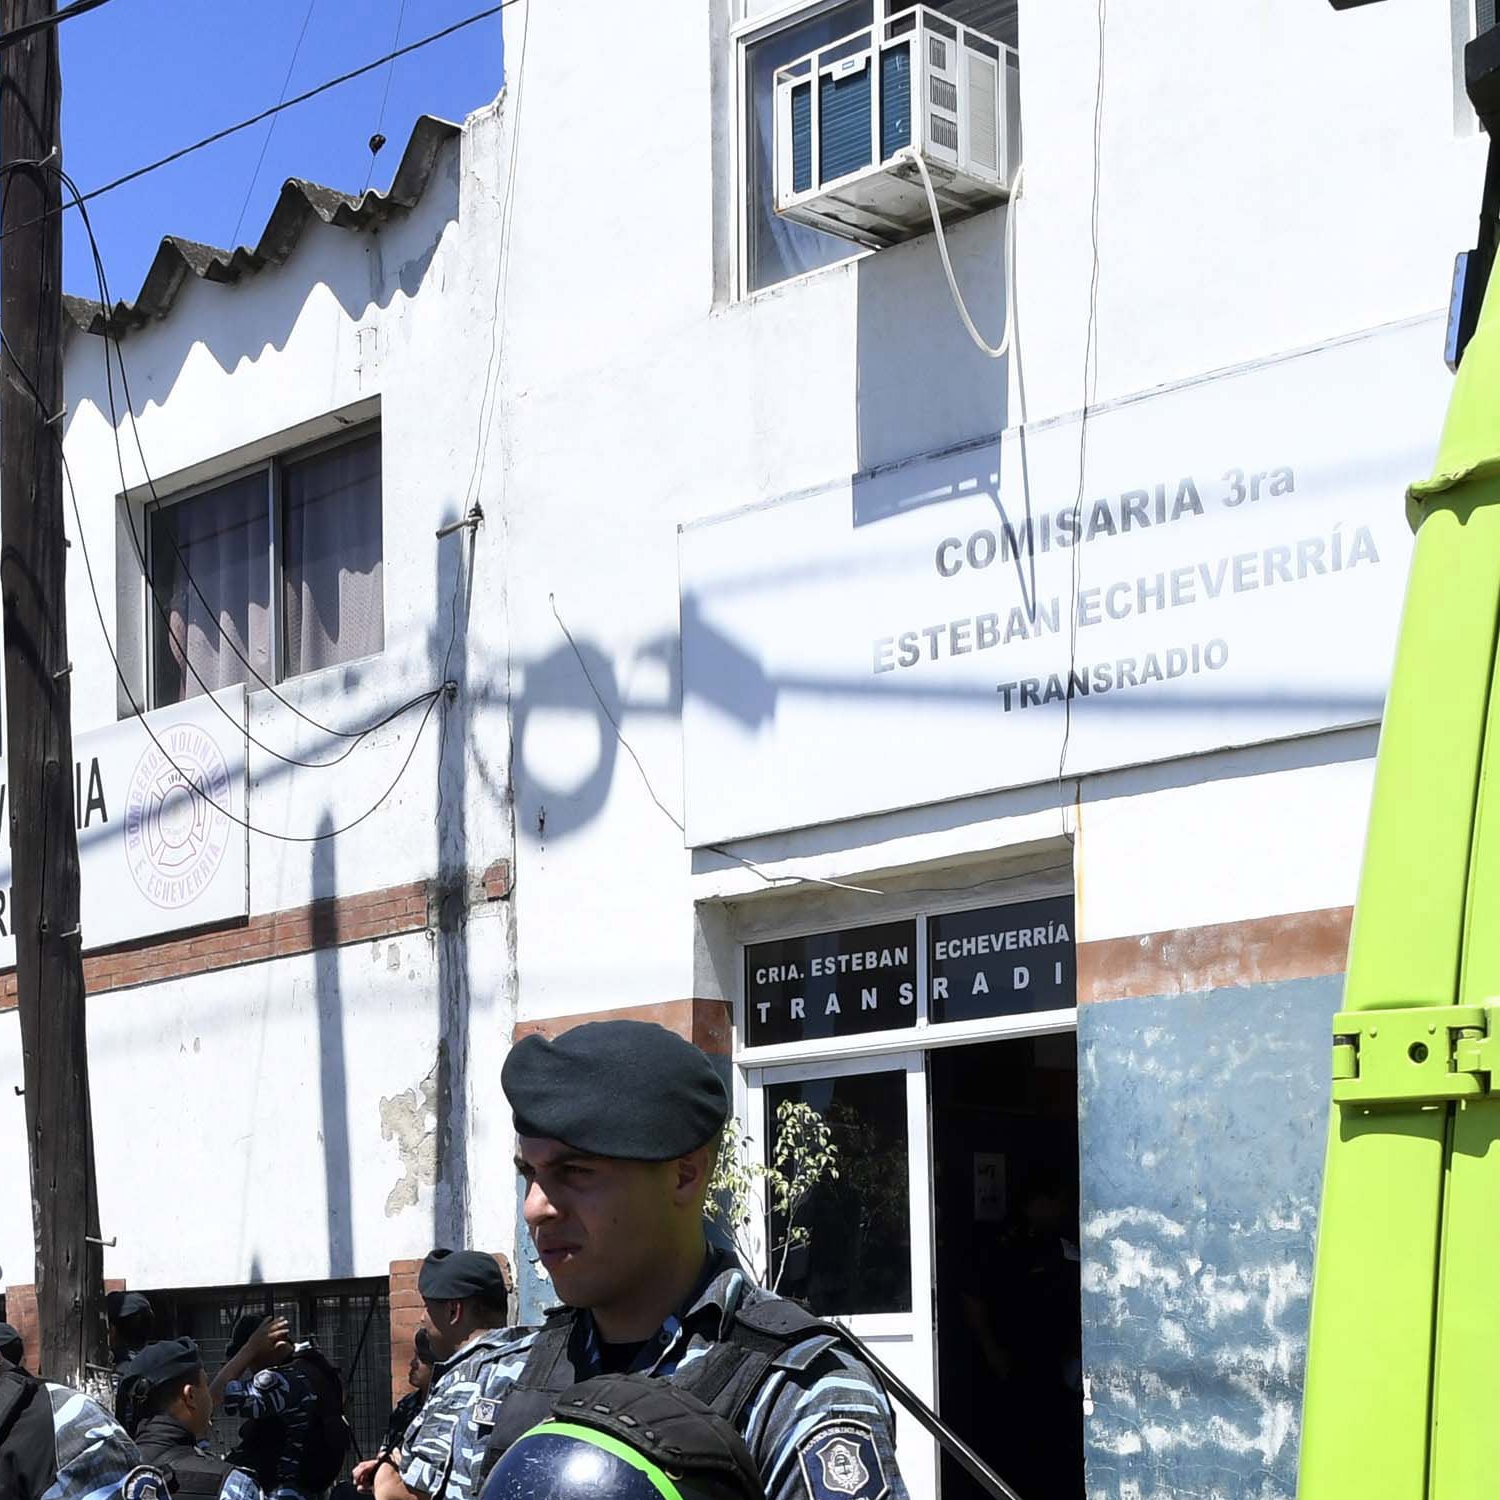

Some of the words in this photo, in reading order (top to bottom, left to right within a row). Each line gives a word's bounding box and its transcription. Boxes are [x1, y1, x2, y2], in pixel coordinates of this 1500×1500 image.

[935, 475, 1205, 577] COMISARIA
[1221, 466, 1295, 508] 3ra
[872, 595, 1060, 674] ESTEBAN
[1078, 521, 1380, 628] ECHEVERRÍA
[997, 637, 1229, 713] TRANSRADIO
[756, 963, 805, 985] CRIA.
[811, 946, 909, 977] ESTEBAN
[935, 919, 1070, 961] ECHEVERRÍA
